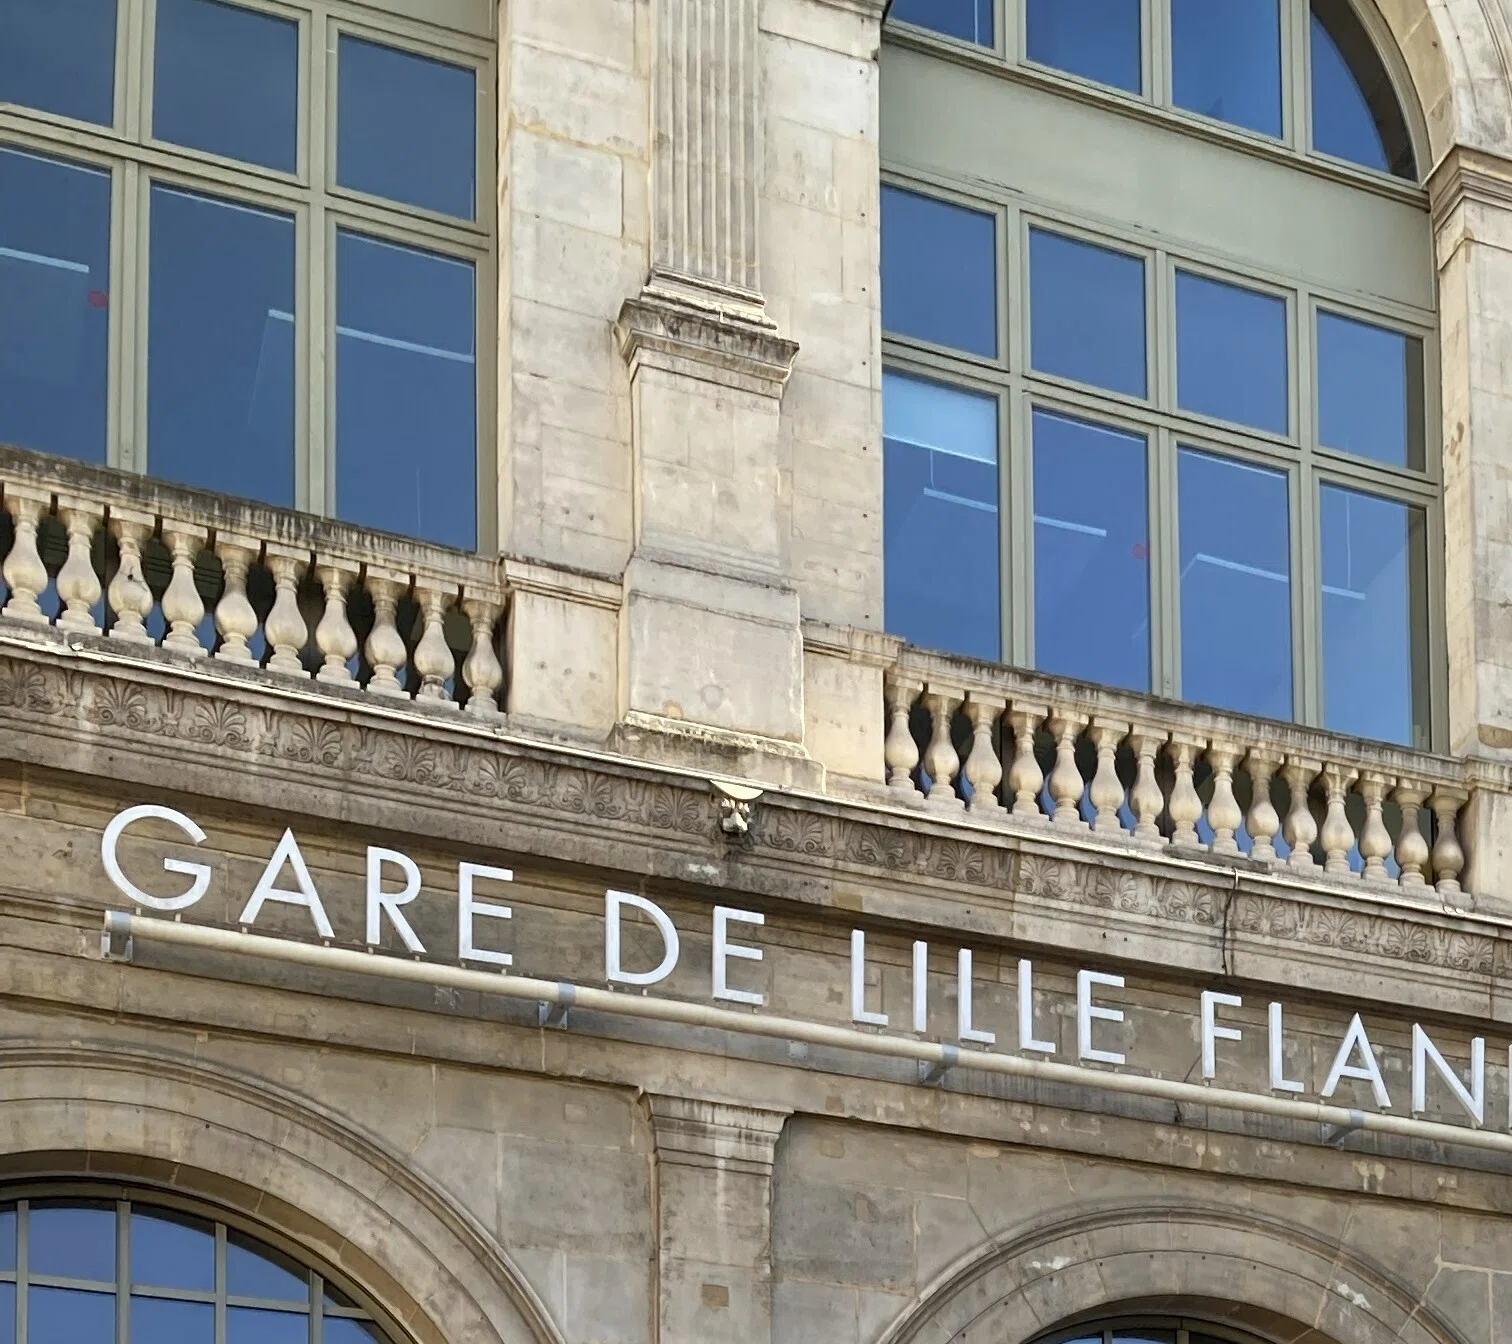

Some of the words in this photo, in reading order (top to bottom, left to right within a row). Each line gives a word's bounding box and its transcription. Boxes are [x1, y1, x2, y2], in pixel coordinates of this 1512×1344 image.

[101, 804, 513, 966] GARE
[605, 889, 765, 1005] DE
[850, 929, 1125, 1065] LILLE
